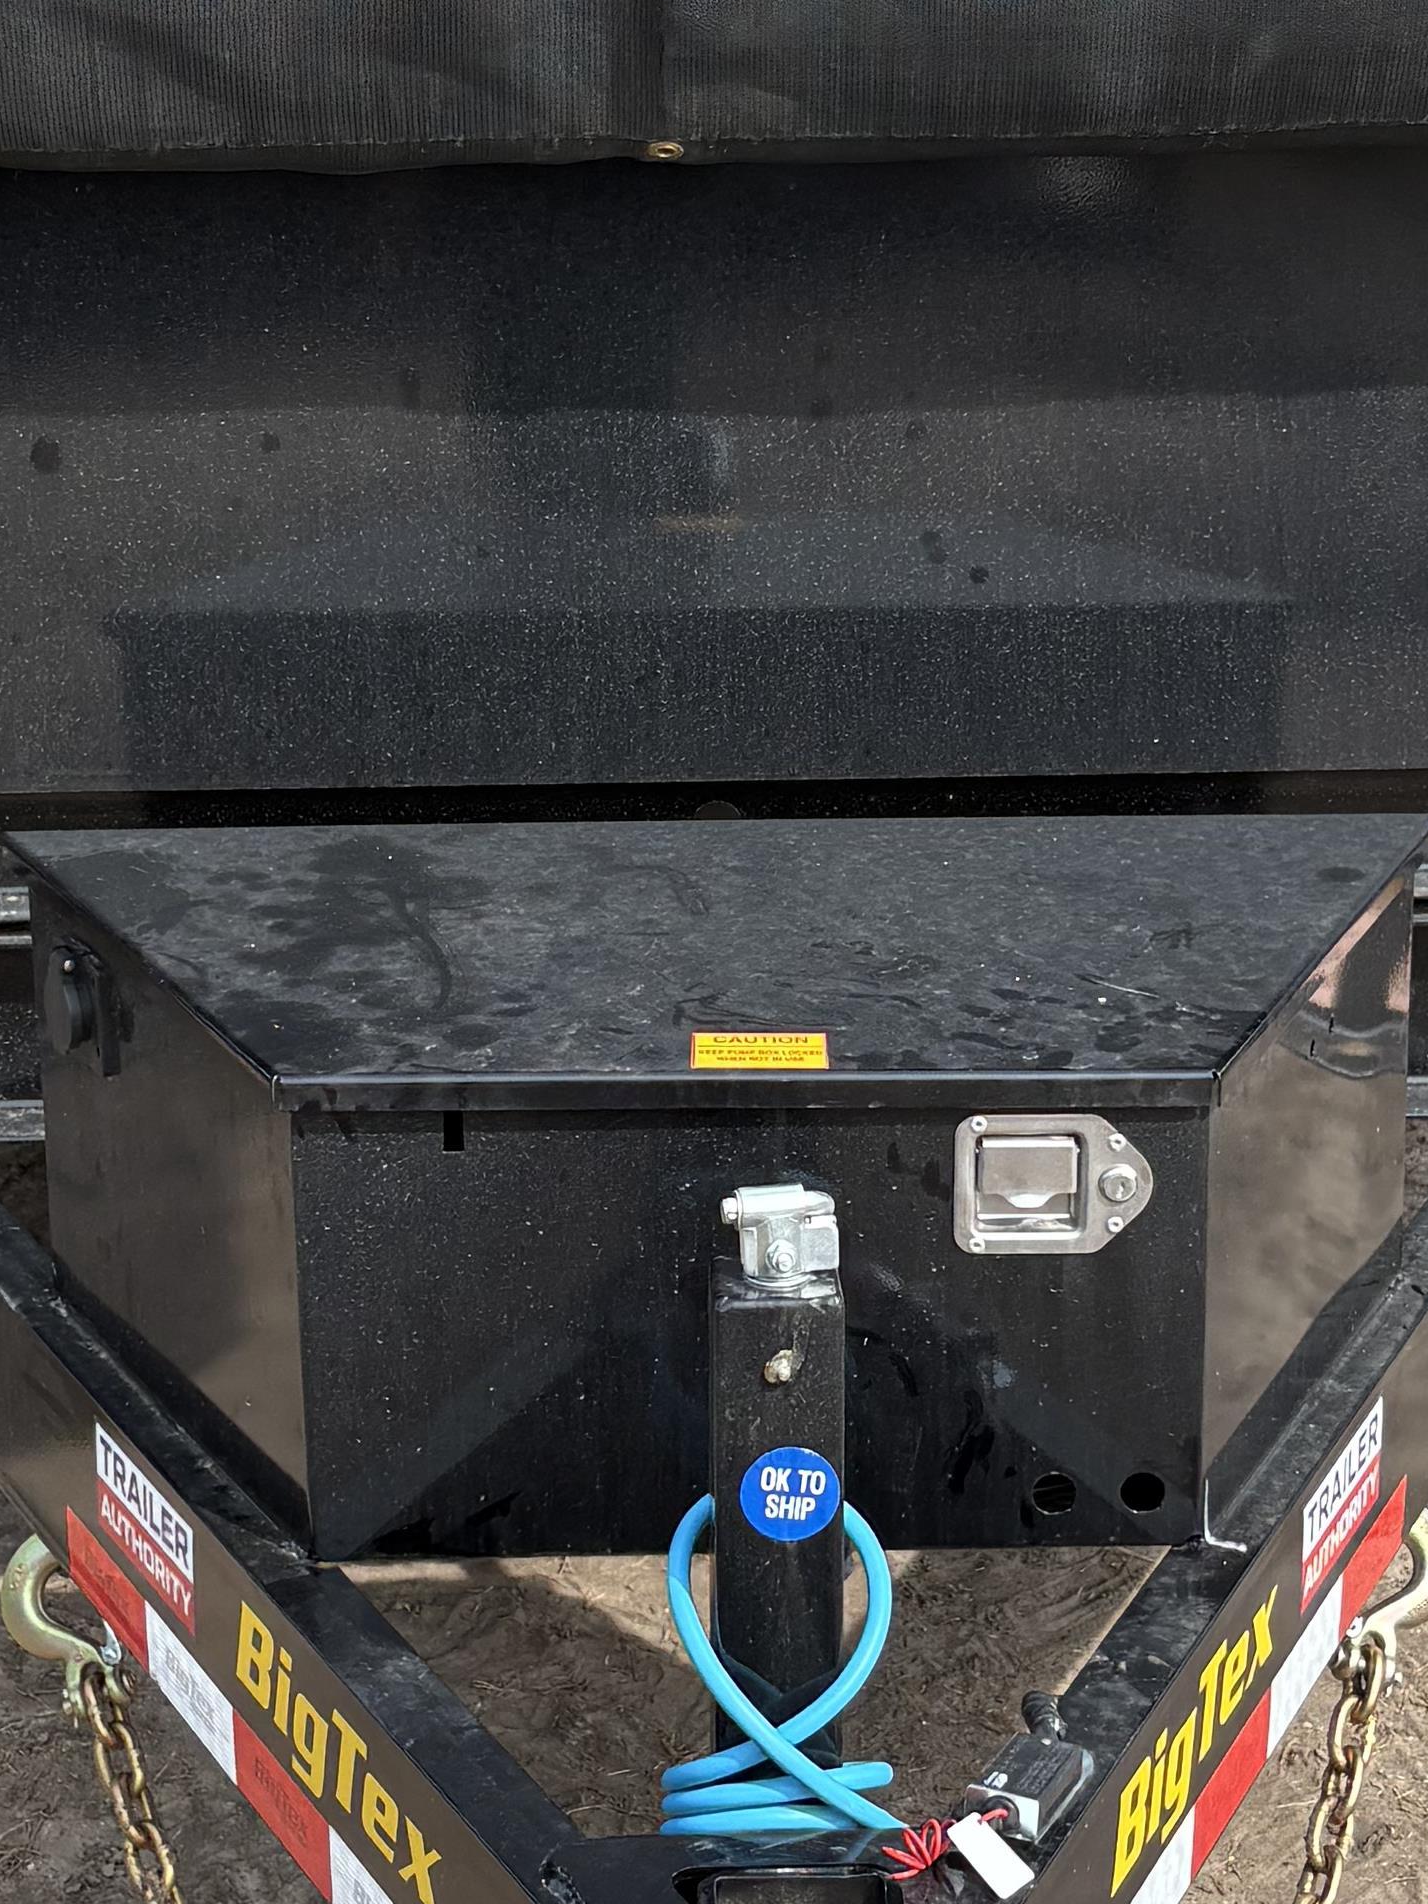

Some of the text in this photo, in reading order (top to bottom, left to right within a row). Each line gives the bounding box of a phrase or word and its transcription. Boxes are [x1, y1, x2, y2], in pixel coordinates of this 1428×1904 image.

[713, 1036, 808, 1044] CAUTION
[99, 1433, 191, 1572] TRAILER
[760, 1466, 826, 1496] OK TO
[765, 1494, 816, 1521] SHIP
[1303, 1466, 1380, 1593] AUTHORITY
[1308, 1413, 1379, 1543] TRAILER
[101, 1493, 192, 1617] AUTHORITY
[1110, 1584, 1278, 1899] BigTex
